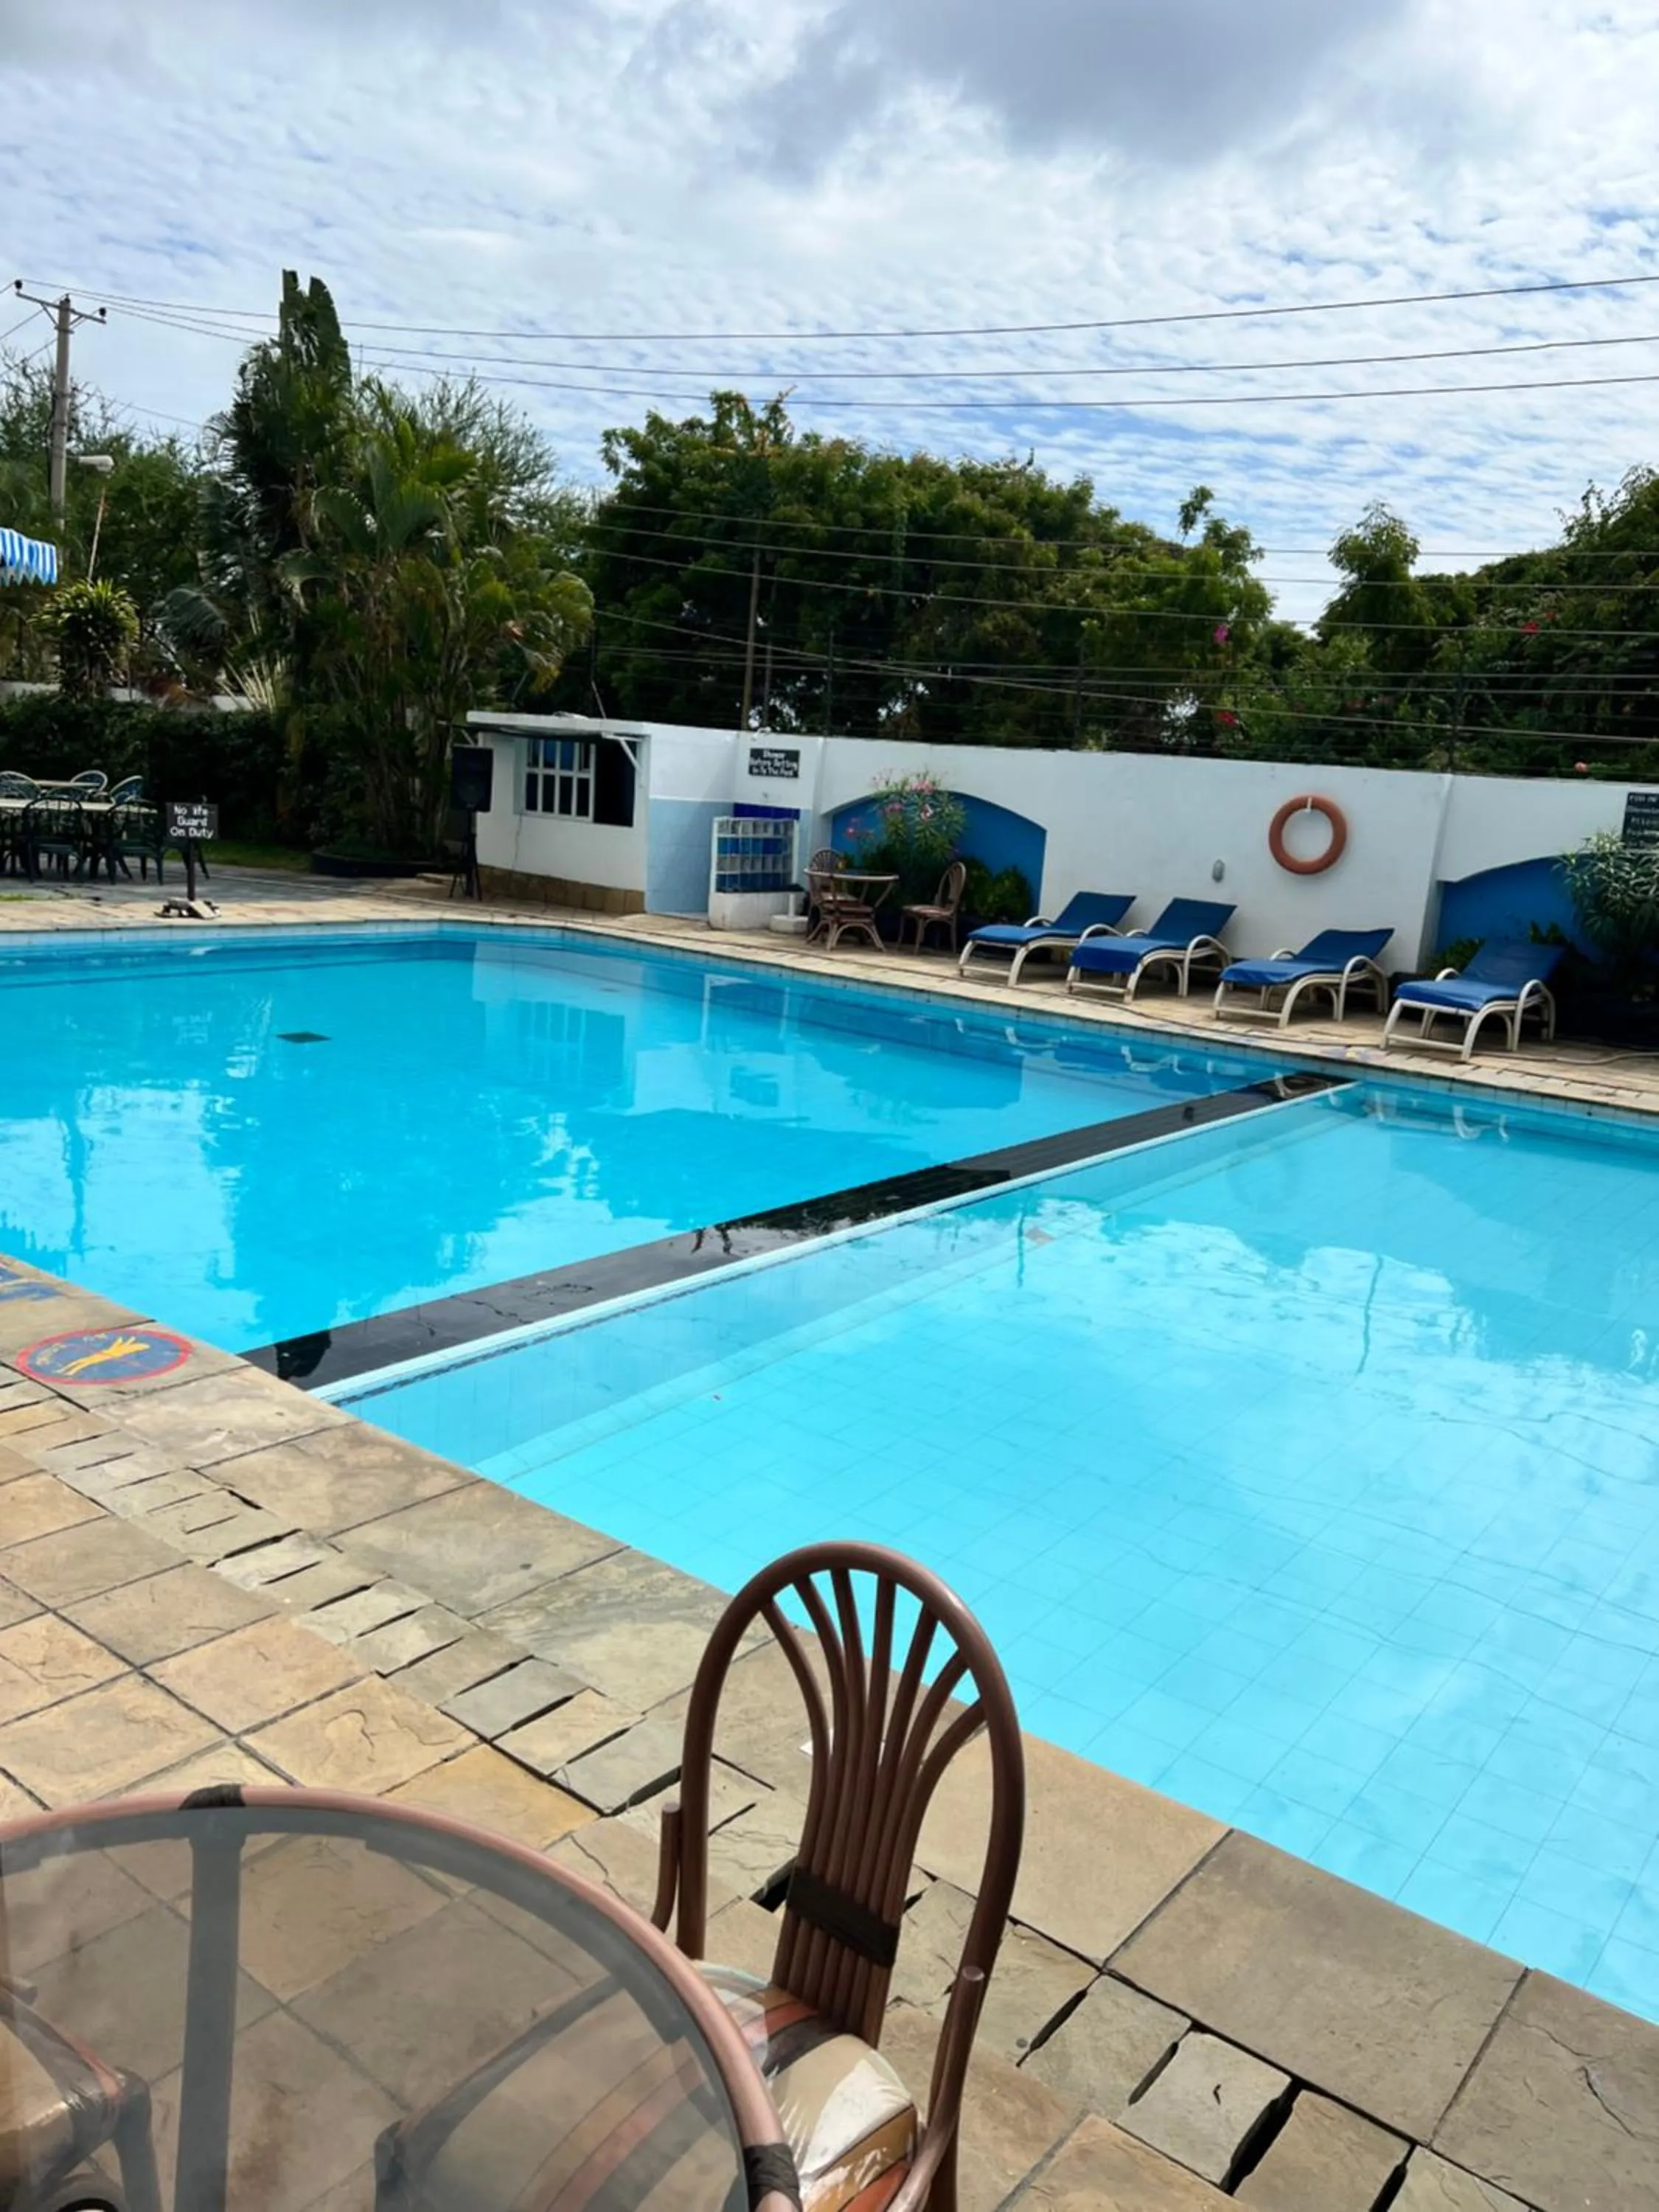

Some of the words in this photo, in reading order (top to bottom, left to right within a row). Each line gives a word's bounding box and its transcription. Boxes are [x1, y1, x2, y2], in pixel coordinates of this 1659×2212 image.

[174, 805, 188, 815] No
[177, 815, 207, 826] Guard
[170, 827, 186, 837] On
[189, 827, 214, 839] Duty
